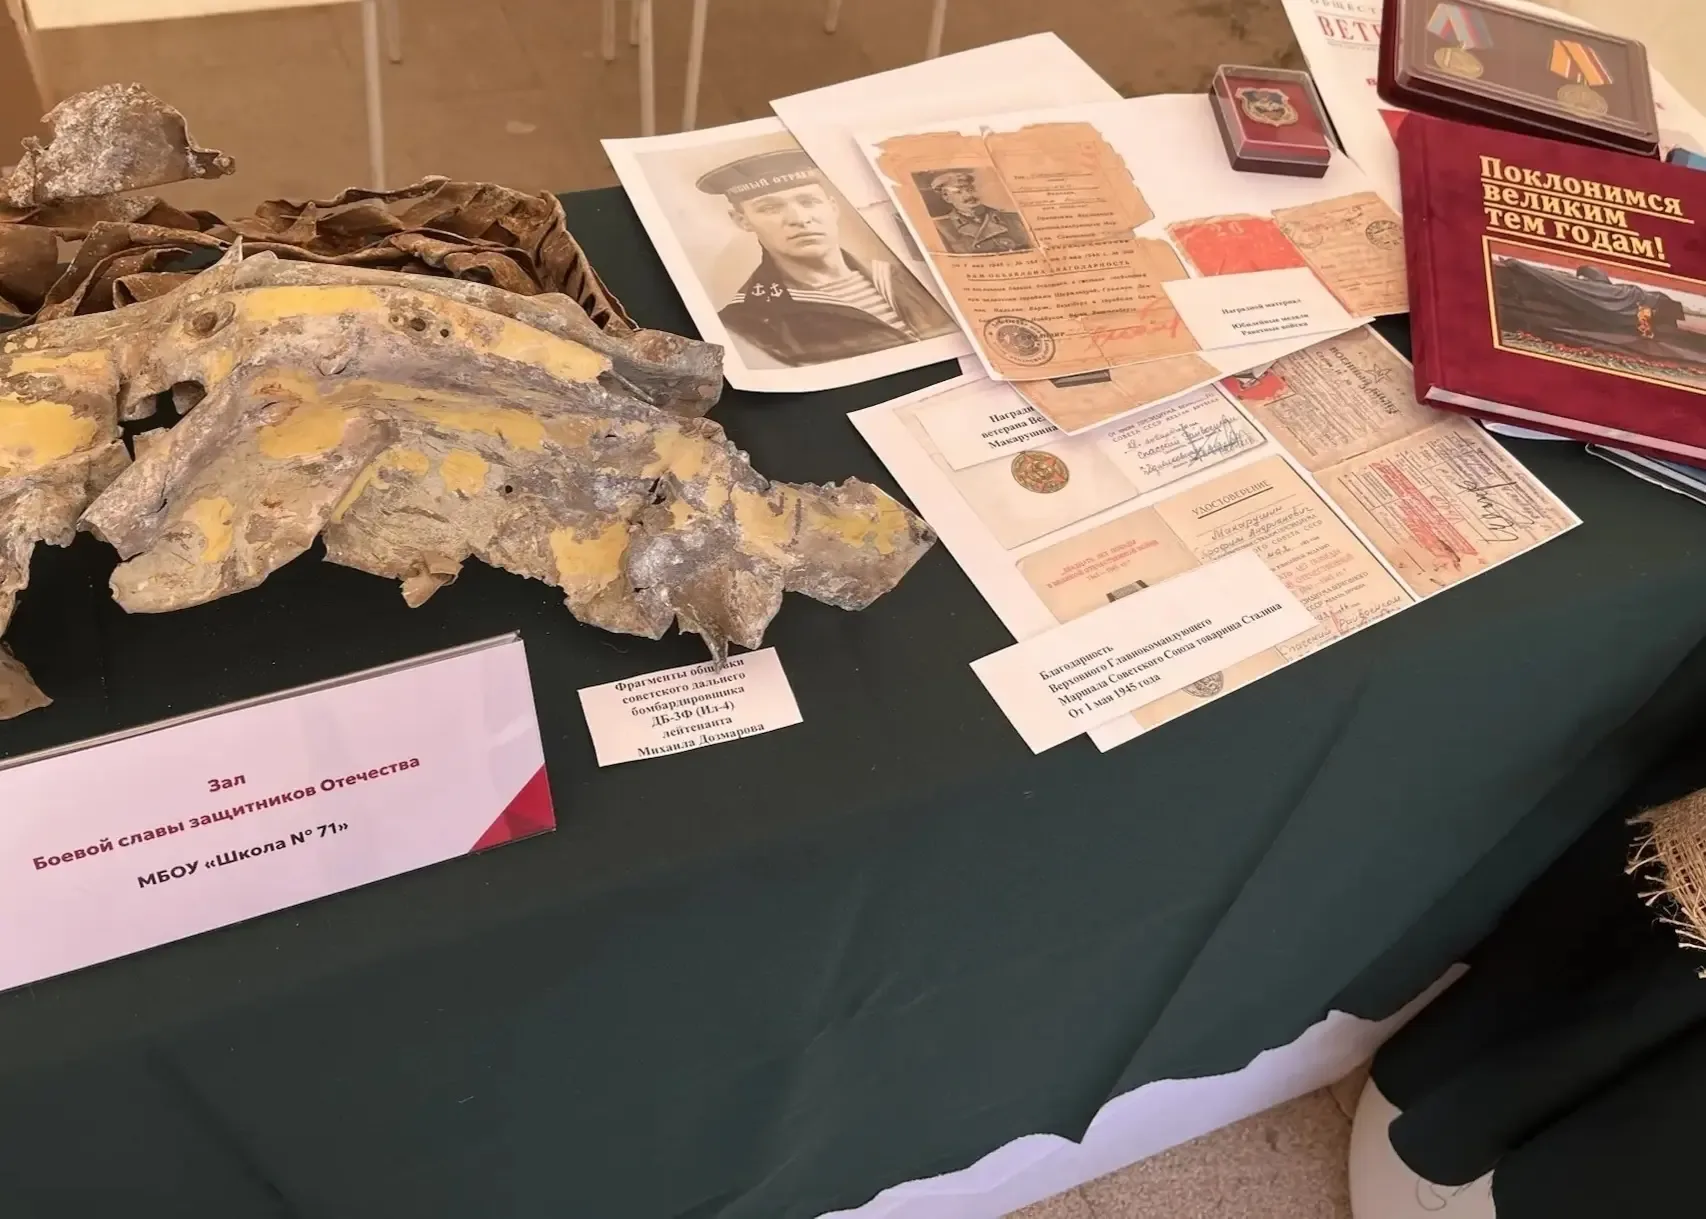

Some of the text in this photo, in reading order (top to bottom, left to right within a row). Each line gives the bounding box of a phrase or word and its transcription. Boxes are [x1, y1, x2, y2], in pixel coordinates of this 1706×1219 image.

[1479, 155, 1683, 218] Поклонимся
[1483, 182, 1629, 229] великим
[1484, 207, 1665, 261] тем годам!
[1231, 317, 1280, 330] Юбилейные
[1240, 321, 1309, 336] Ракетные войска
[981, 420, 1028, 439] ветерана
[988, 425, 1059, 449] Макарушина
[1192, 481, 1271, 517] УДОСТОВЕРЕНИЕ
[1039, 644, 1114, 682] Благодарность
[1047, 617, 1213, 695] Верховного Главнокомандующего
[1057, 680, 1108, 706] Маршала
[1107, 653, 1165, 684] Советского
[1163, 638, 1196, 662] Союза
[1195, 619, 1243, 648] товарища
[1241, 601, 1283, 626] Сталина
[614, 658, 746, 692] Фрагменты обшвки
[622, 672, 746, 704] советского дальнего
[631, 685, 746, 717] бомбардировщика
[1068, 671, 1162, 719] От 1 мая 1945 года
[650, 700, 736, 728] ДБ-3Ф (Ил-4)
[661, 715, 734, 740] лейтенанта
[637, 723, 765, 758] Михаила Дозмарова
[206, 774, 247, 793] Зал
[32, 755, 421, 871] Боевой славы защитников Отечества
[136, 858, 200, 889] МБОУ
[204, 838, 287, 871] «Школа
[317, 820, 350, 840] 71»
